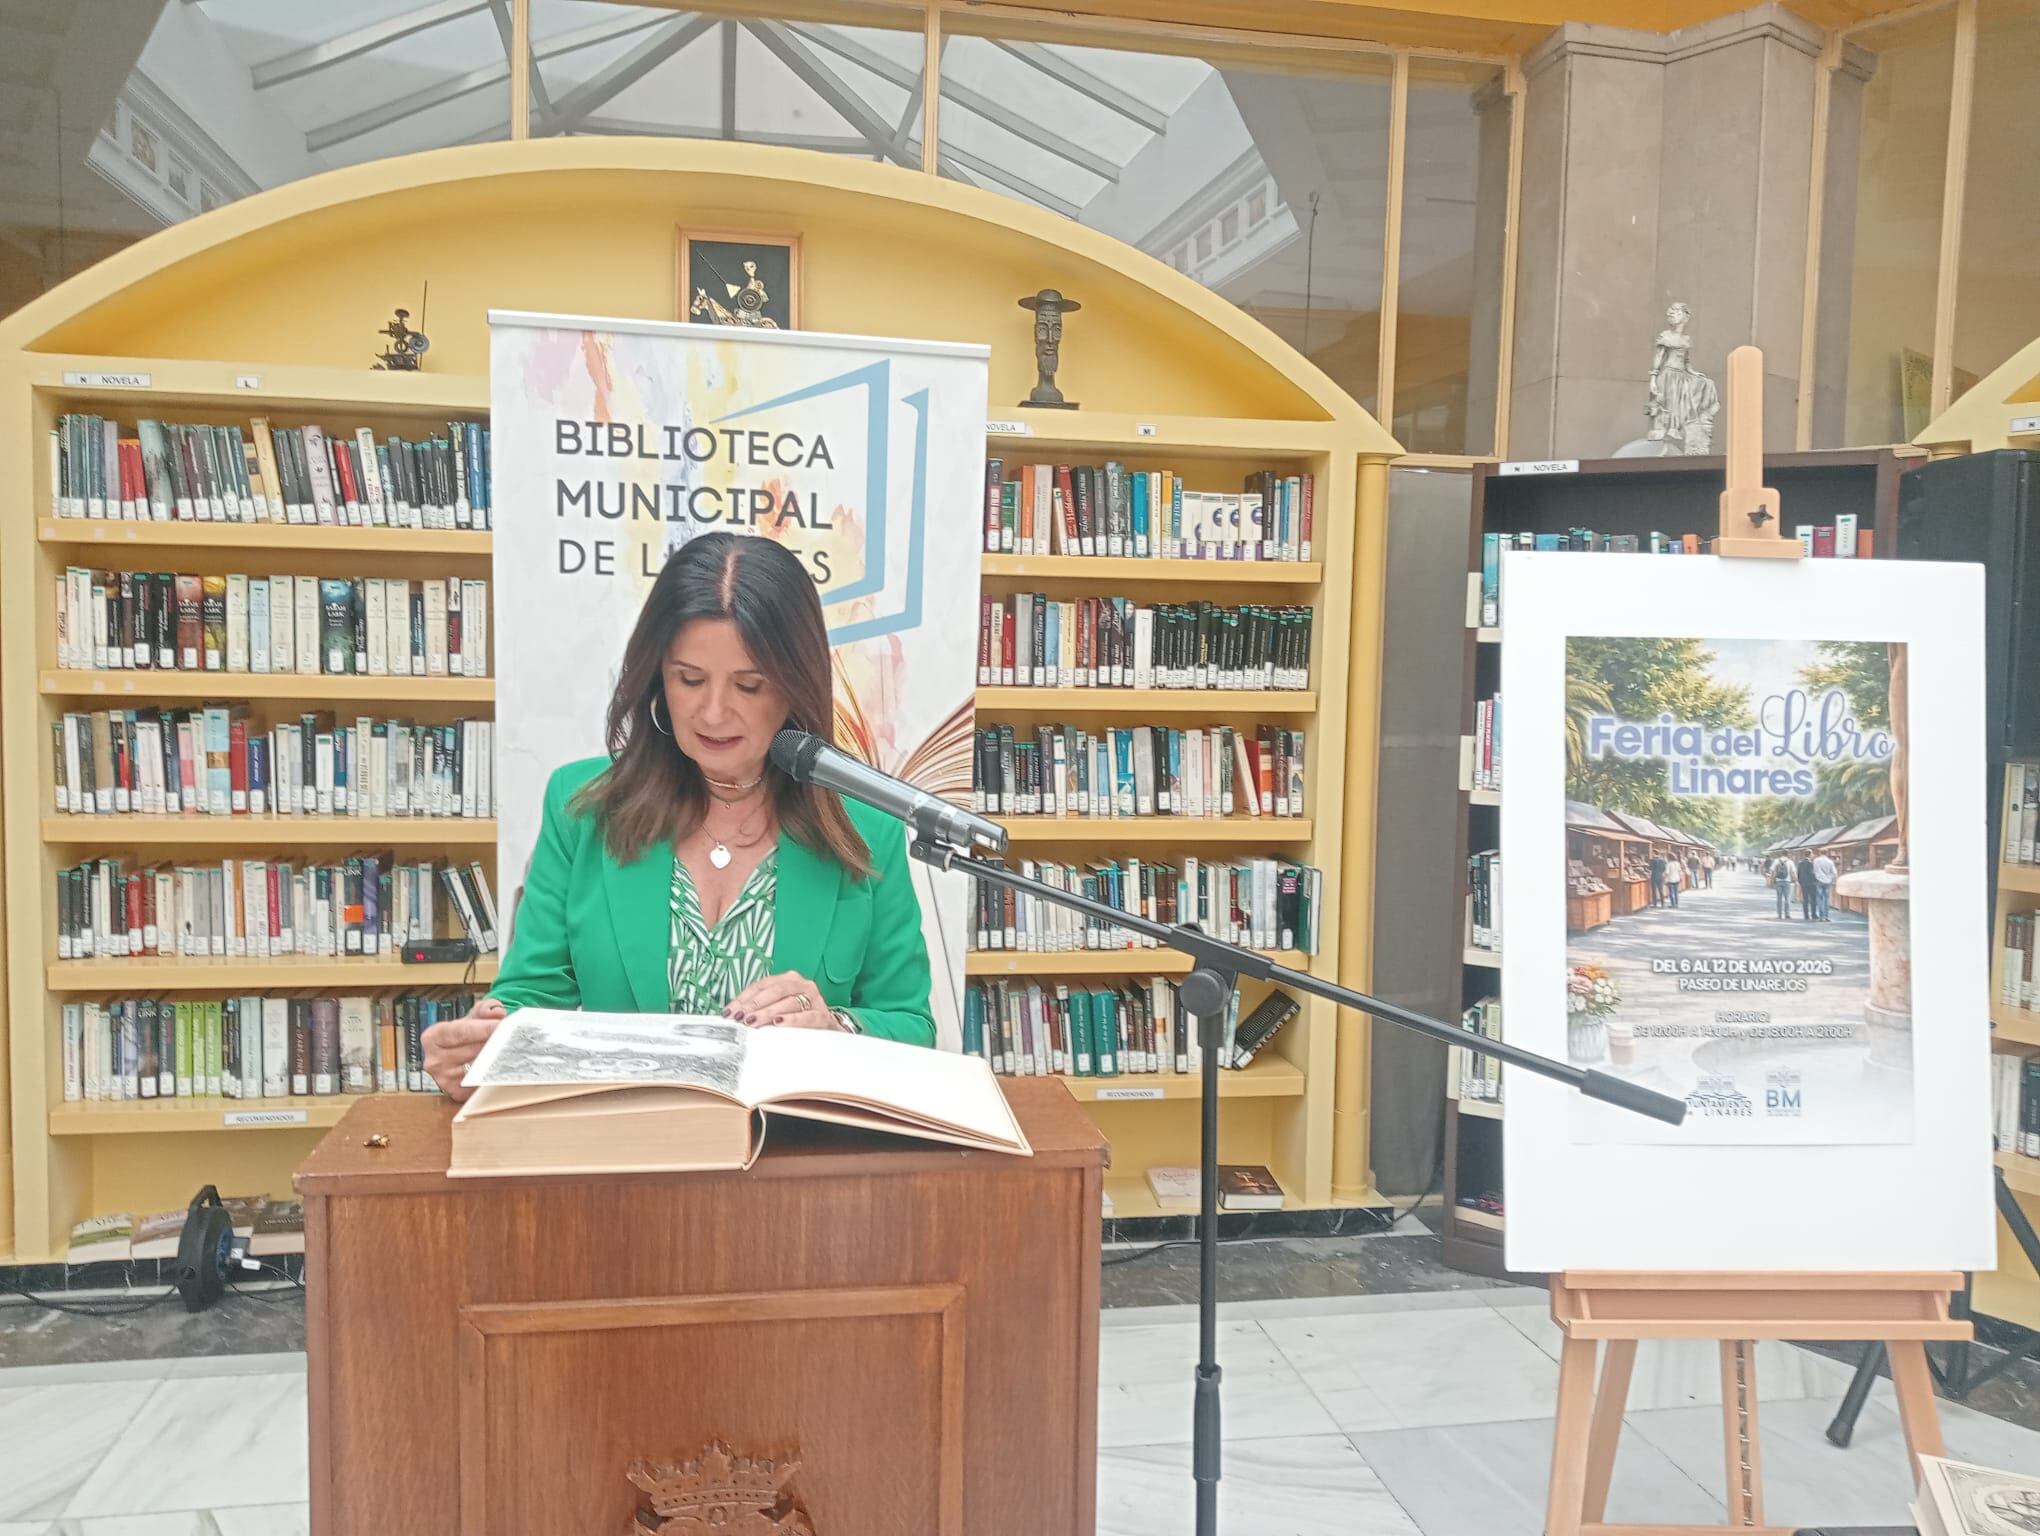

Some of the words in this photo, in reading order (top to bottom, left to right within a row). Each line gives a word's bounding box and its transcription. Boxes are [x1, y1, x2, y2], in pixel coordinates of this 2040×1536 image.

[101, 375, 140, 385] NOVELA
[1143, 427, 1150, 435] M
[555, 419, 835, 470] BIBLIOTECA
[1533, 463, 1568, 472] NOVELA
[556, 479, 833, 530] MUNICIPAL
[559, 539, 615, 576] DE
[1591, 714, 1702, 757] Feria
[1711, 729, 1761, 757] del
[1761, 689, 1895, 765] Libro
[1672, 758, 1813, 795] Linares
[1653, 960, 1679, 974] DEL
[1681, 960, 1691, 974] 6
[1692, 960, 1711, 974] AL
[1712, 960, 1727, 974] 12
[1729, 960, 1747, 974] DE
[1750, 960, 1795, 974] MAYO
[1796, 960, 1832, 974] 2026
[1679, 978, 1721, 991] PASEO
[1723, 978, 1740, 991] DE
[1741, 979, 1807, 992] LINAREJOS
[1633, 1025, 1649, 1037] DE
[1749, 1026, 1766, 1038] DE
[1766, 1089, 1801, 1108] BM
[1704, 1108, 1752, 1117] LINARES
